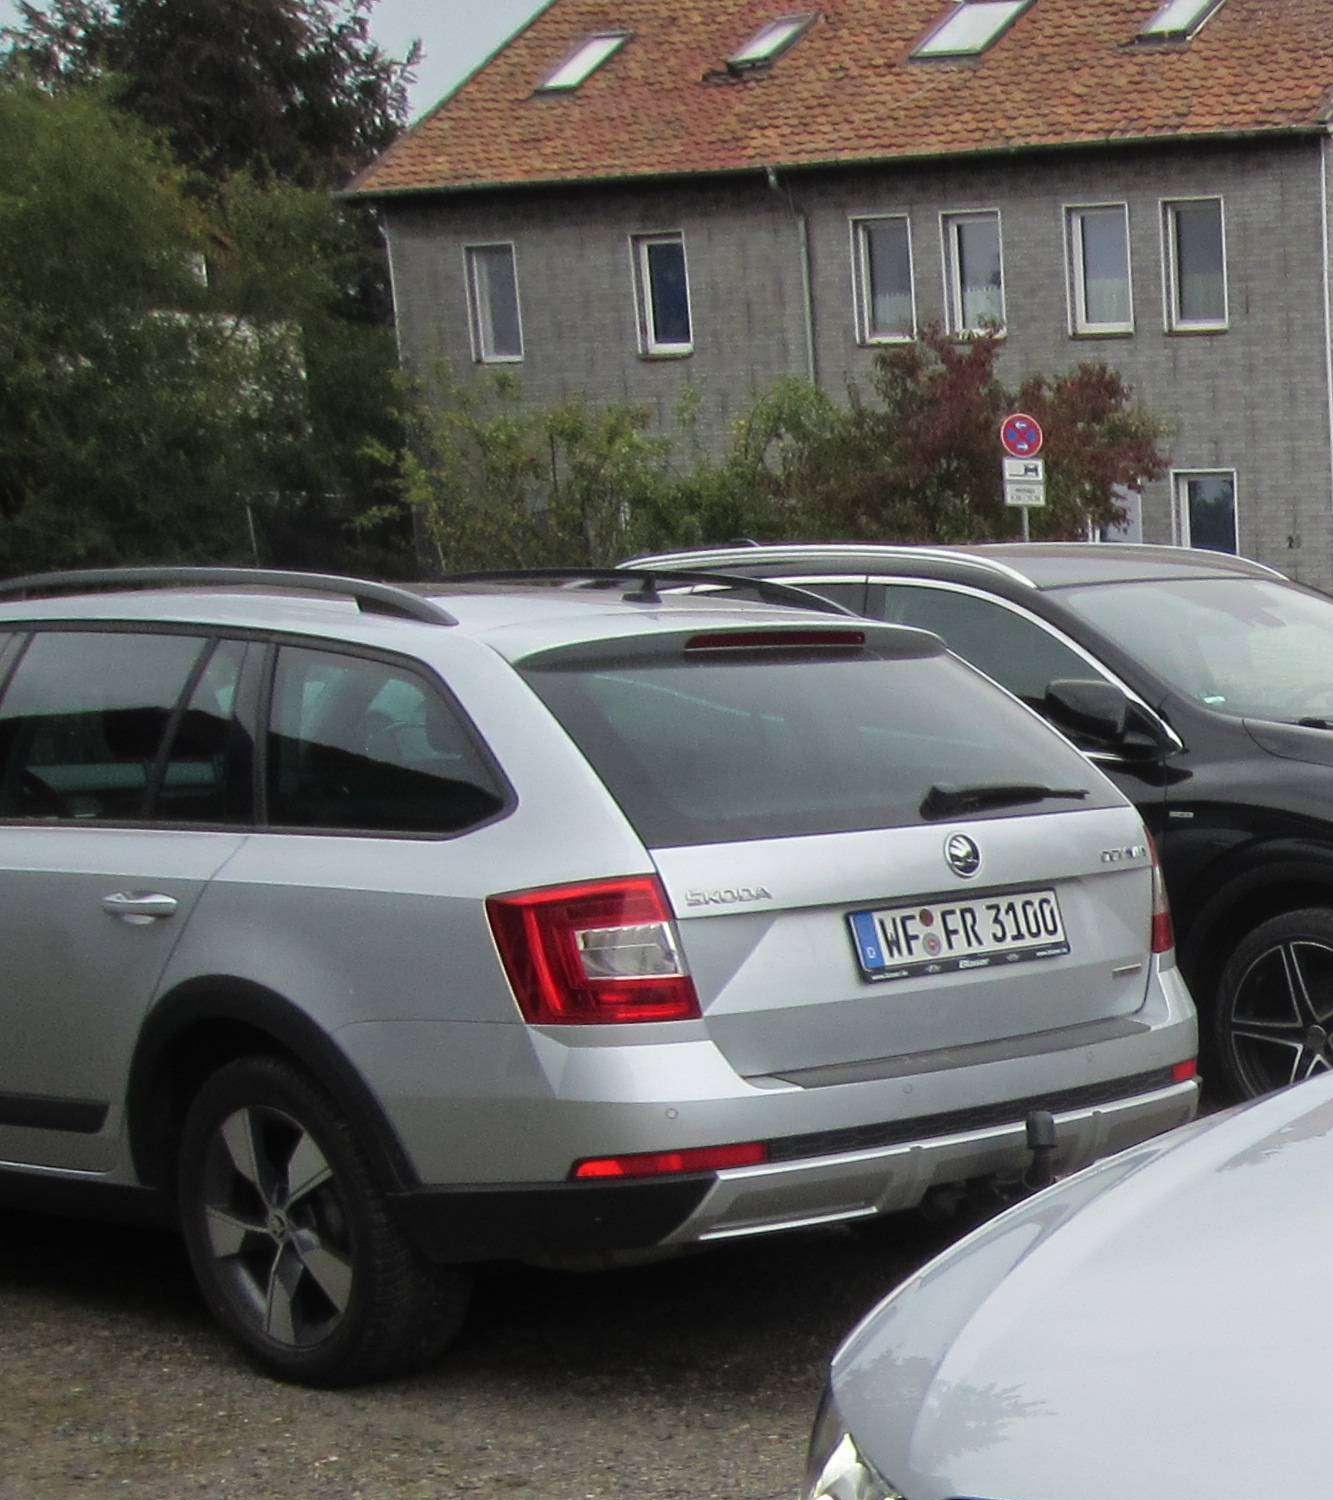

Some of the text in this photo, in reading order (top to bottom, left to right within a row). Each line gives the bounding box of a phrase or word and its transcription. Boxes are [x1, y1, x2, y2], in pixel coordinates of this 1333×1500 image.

[878, 897, 1059, 959] WF FR 3100
